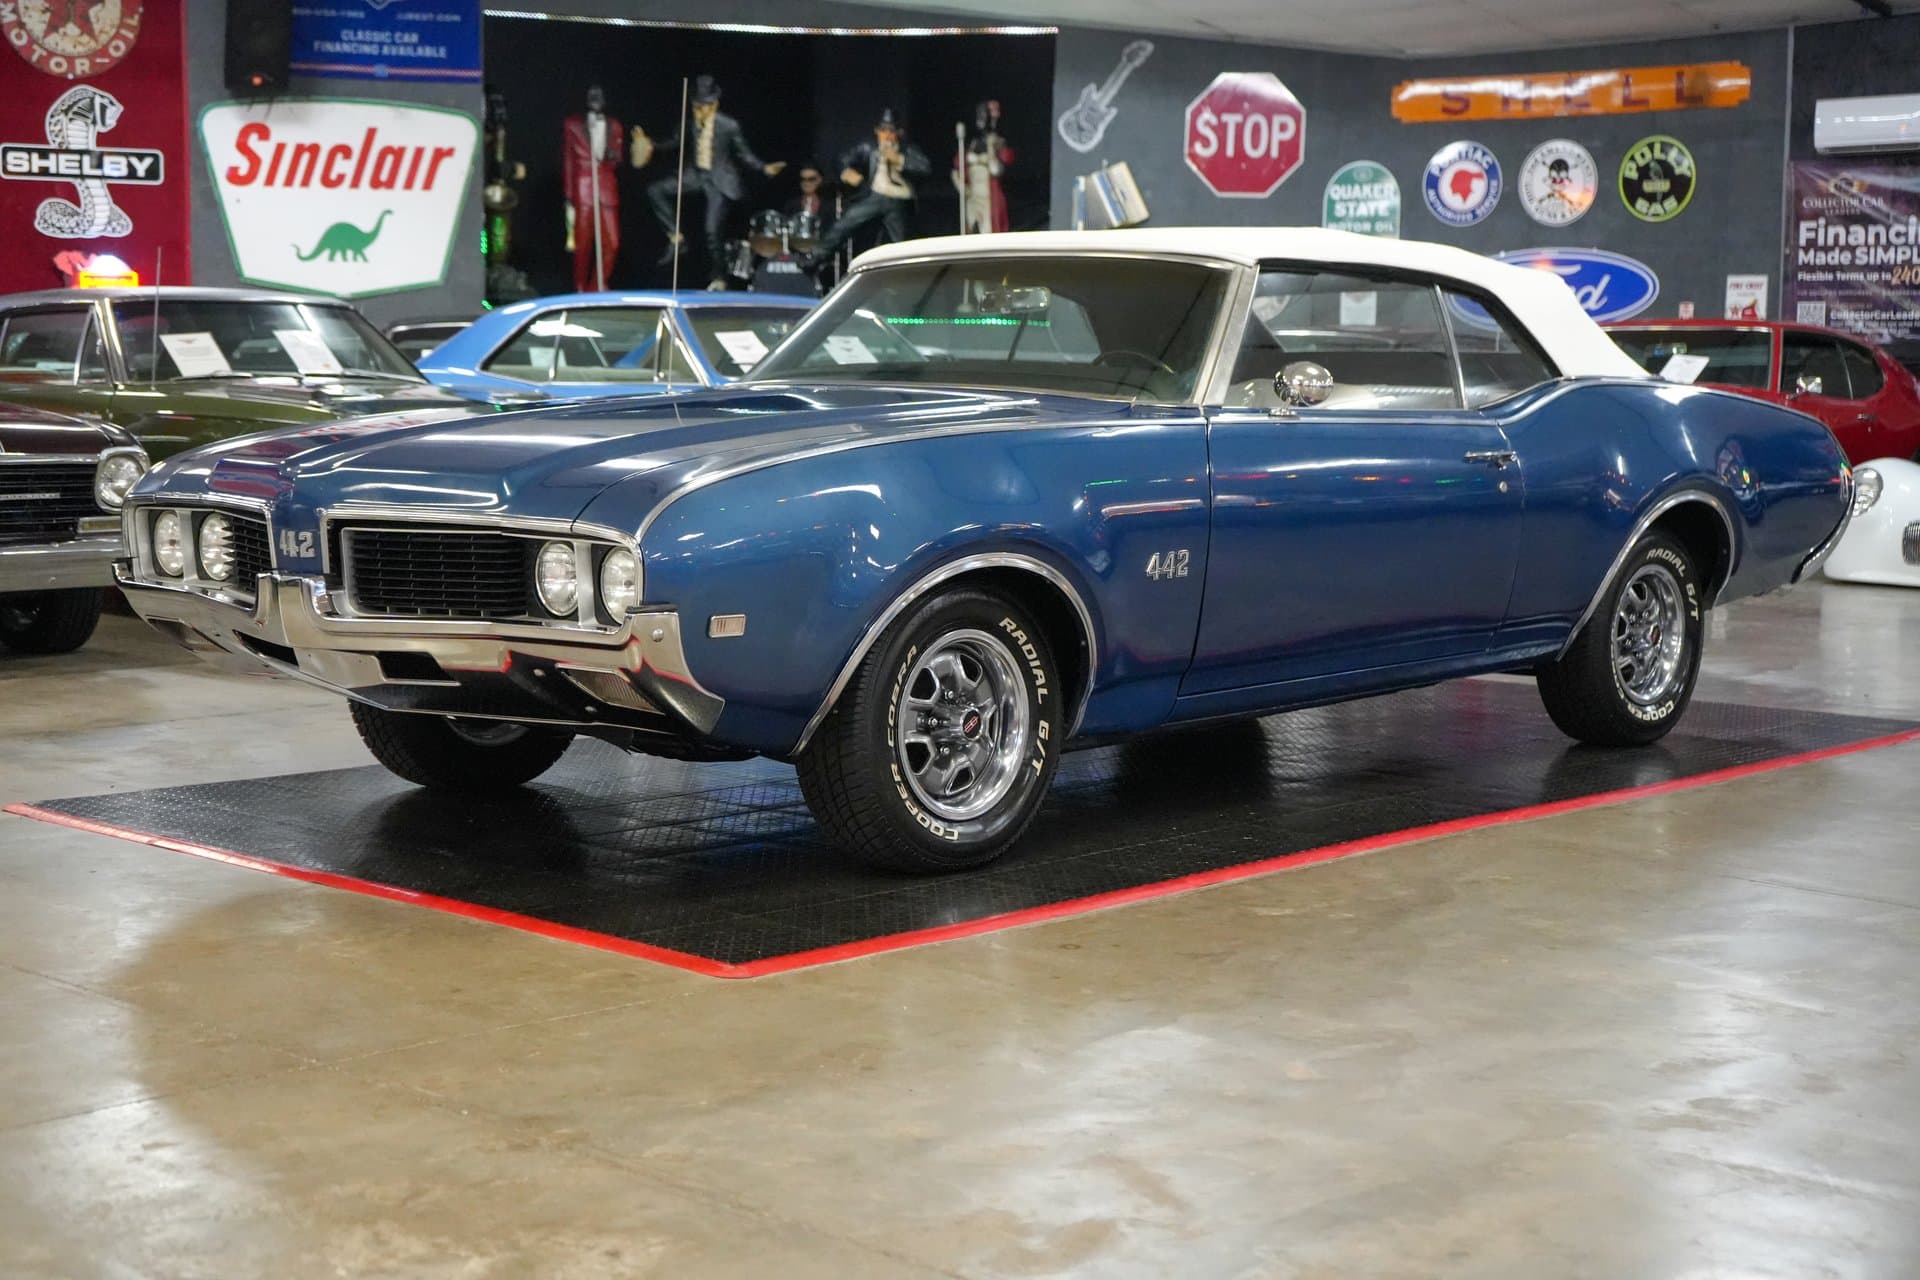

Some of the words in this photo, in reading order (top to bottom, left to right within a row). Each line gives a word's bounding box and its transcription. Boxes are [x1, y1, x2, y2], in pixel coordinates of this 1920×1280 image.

[313, 40, 379, 55] FINANCING
[381, 44, 447, 59] AVAILABLE
[340, 29, 392, 43] CLASSIC
[394, 31, 419, 44] CAR
[1194, 112, 1297, 159] STOP
[6, 151, 154, 177] SHELBY
[226, 122, 455, 191] Sinclair
[1624, 141, 1692, 180] POLLY
[1329, 183, 1397, 201] QUAKER
[1635, 195, 1678, 217] GAS
[1334, 201, 1390, 217] STATE
[1800, 215, 1920, 247] Financi
[1798, 247, 1852, 266] Made
[1798, 271, 1833, 281] Flexible
[1836, 271, 1864, 281] Terms
[1867, 272, 1879, 283] up
[1882, 271, 1891, 281] to
[1146, 549, 1190, 580] 442
[1647, 548, 1685, 577] RADIAL
[1685, 583, 1699, 621] G/T
[887, 644, 917, 748] COBRA
[999, 617, 1048, 704] RADIAL
[1031, 720, 1049, 777] G/T
[891, 763, 959, 841] COOPER
